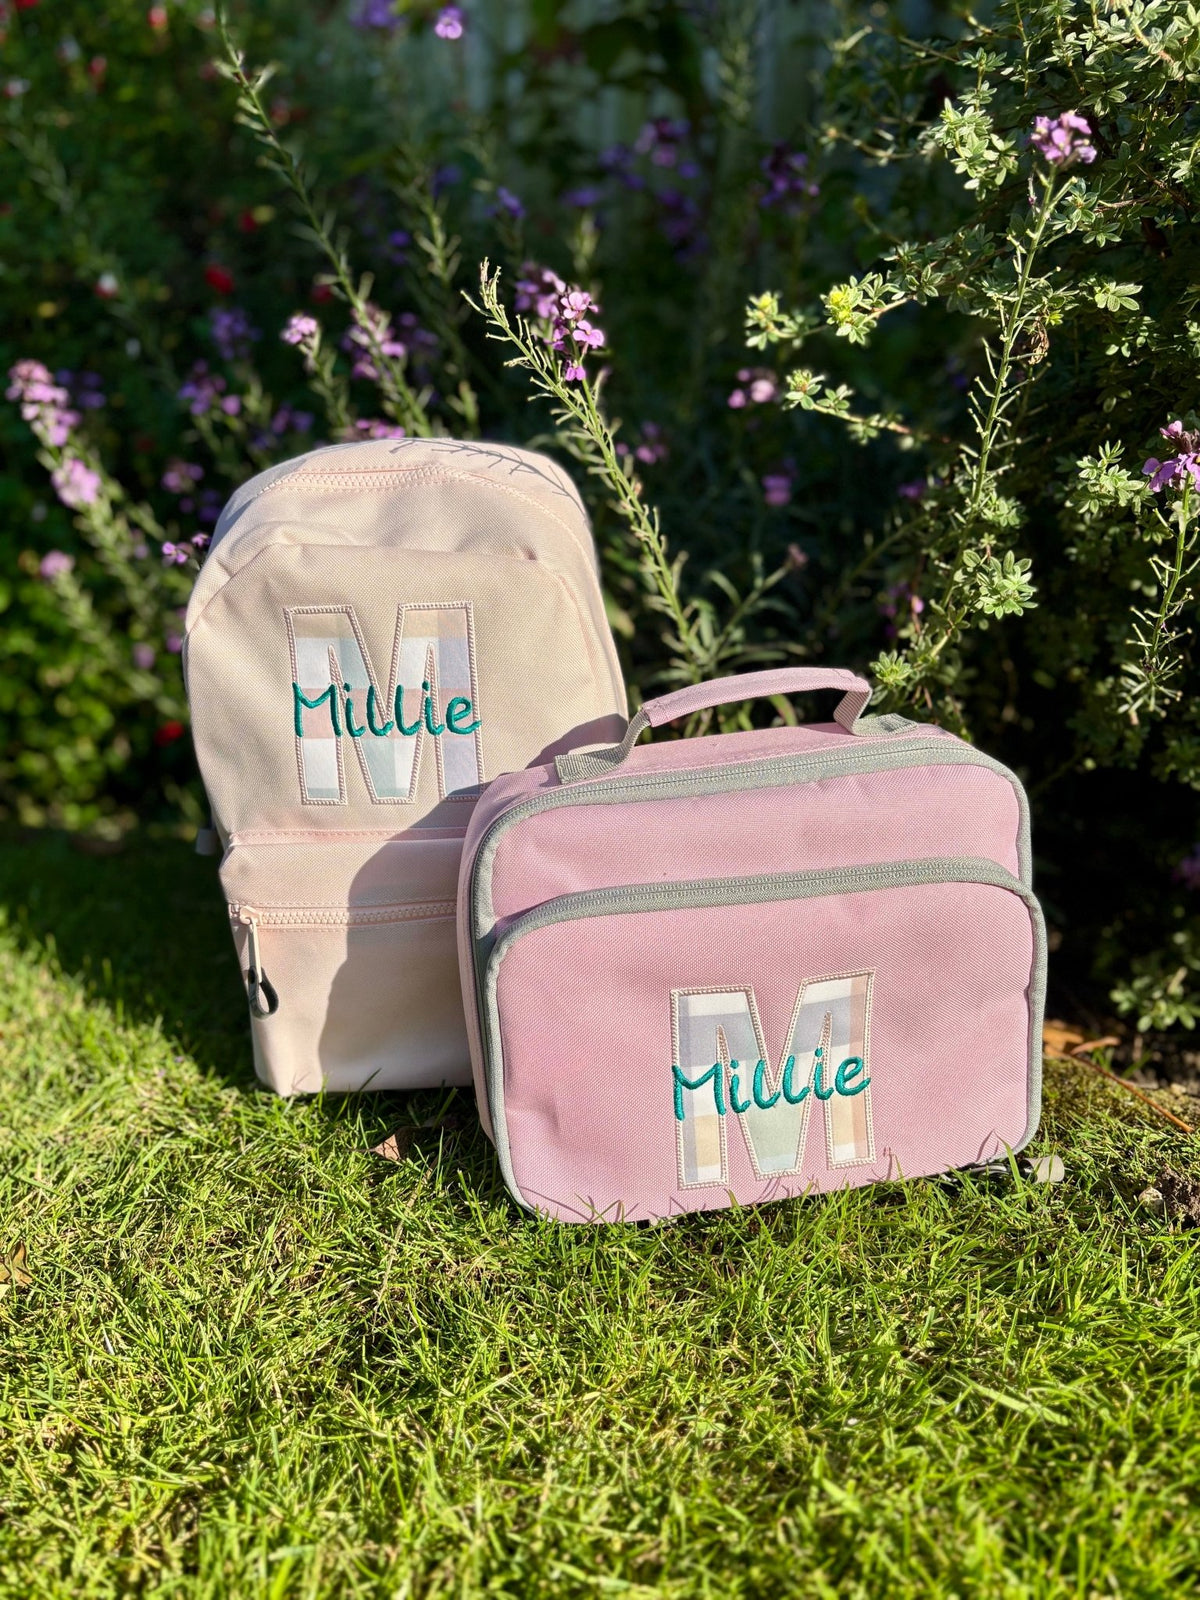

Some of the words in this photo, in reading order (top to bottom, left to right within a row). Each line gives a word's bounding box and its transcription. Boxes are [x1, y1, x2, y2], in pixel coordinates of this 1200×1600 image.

[284, 601, 485, 805] M
[292, 681, 482, 738] Millie
[670, 966, 876, 1190] M
[672, 1047, 872, 1121] Millie
